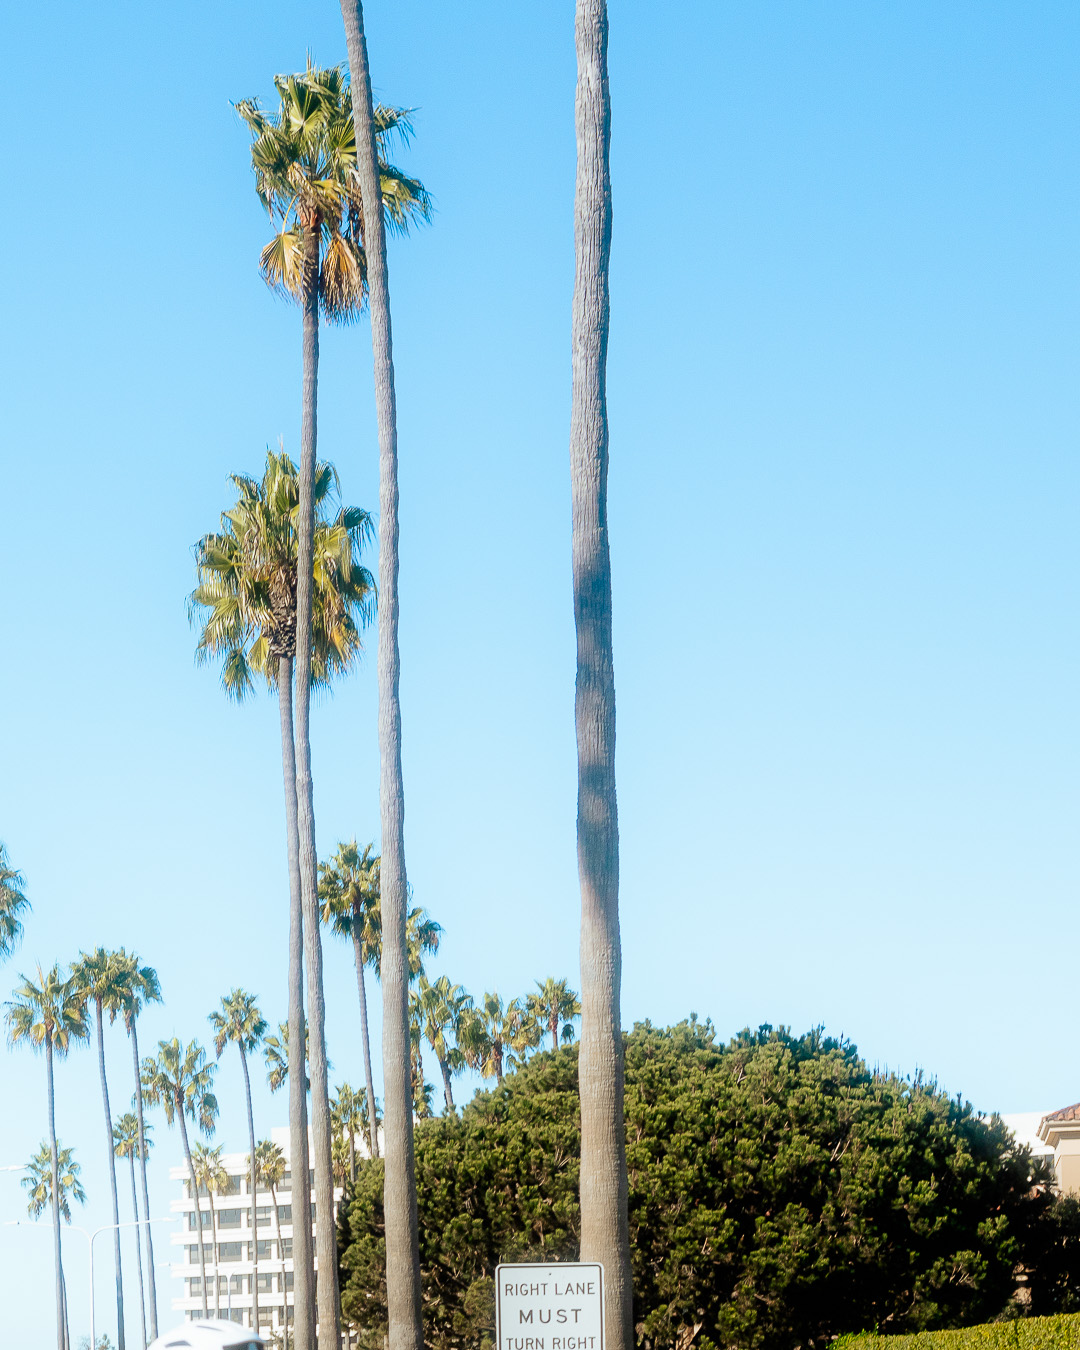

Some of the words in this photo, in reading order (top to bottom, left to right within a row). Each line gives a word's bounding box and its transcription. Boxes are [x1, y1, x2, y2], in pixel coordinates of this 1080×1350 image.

[505, 1283, 548, 1296] RIGHT
[555, 1282, 595, 1295] LANE
[519, 1308, 582, 1324] MUST
[506, 1337, 544, 1350] TURN
[552, 1336, 596, 1349] RIGHT
